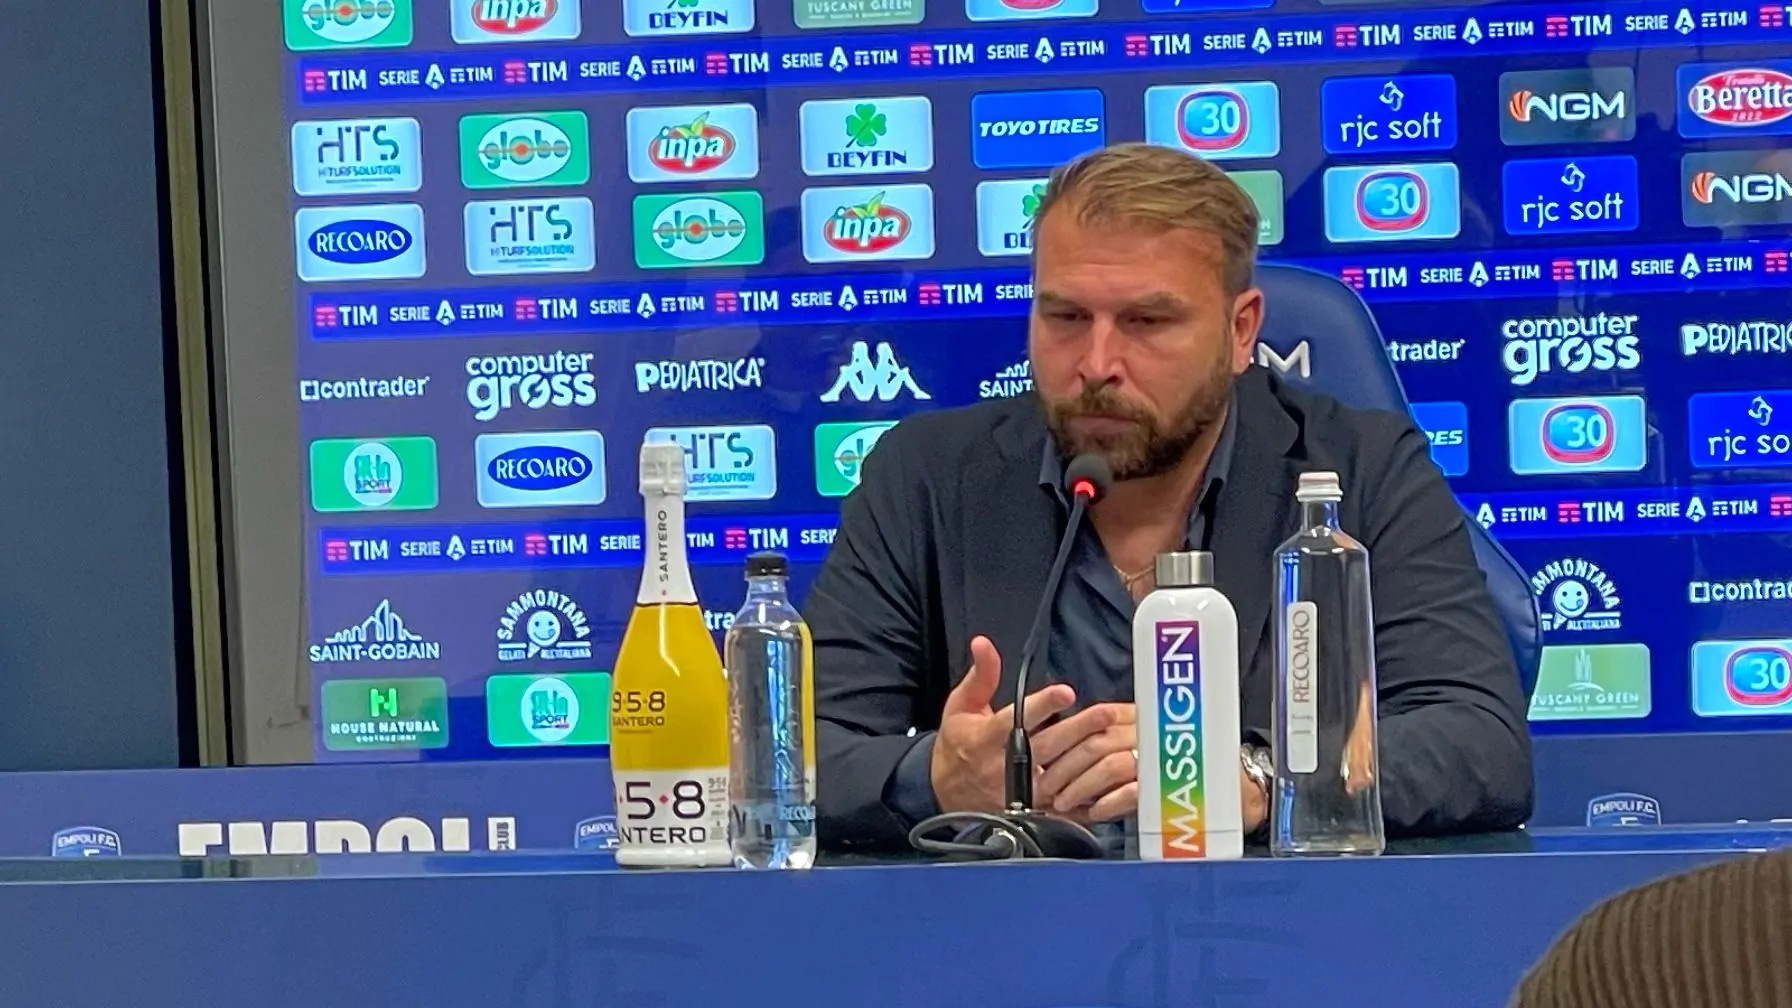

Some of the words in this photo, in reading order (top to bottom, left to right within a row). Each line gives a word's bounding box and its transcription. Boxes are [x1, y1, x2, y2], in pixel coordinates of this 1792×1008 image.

[328, 70, 367, 91] TIM
[379, 71, 420, 86] SERIE
[467, 67, 493, 82] TIM
[528, 62, 568, 83] TIM
[580, 62, 620, 78] SERIE
[669, 59, 695, 74] TIM
[729, 53, 769, 74] TIM
[782, 53, 823, 69] SERIE
[871, 49, 898, 65] TIM
[934, 44, 974, 65] TIM
[987, 45, 1028, 61] SERIE
[1077, 41, 1104, 57] TIM
[1149, 34, 1190, 56] TIM
[1204, 34, 1246, 51] SERIE
[1295, 31, 1323, 47] TIM
[1359, 25, 1400, 46] TIM
[1414, 25, 1456, 41] SERIE
[1506, 21, 1534, 37] TIM
[1571, 15, 1612, 37] TIM
[1625, 15, 1669, 31] SERIE
[1719, 11, 1747, 27] TIM
[1200, 102, 1240, 135] 30
[1525, 91, 1625, 121] NGM
[316, 126, 399, 162] HTS
[1341, 114, 1378, 147] rjc
[1388, 112, 1441, 139] soft
[658, 127, 724, 167] inpa
[827, 150, 907, 168] BEYFIN
[1381, 184, 1420, 216] 30
[1521, 195, 1559, 228] rjc
[1569, 192, 1623, 220] soft
[490, 204, 573, 242] HTS
[834, 206, 901, 247] inpa
[316, 229, 405, 255] RECOARO
[1367, 267, 1408, 288] TIM
[1420, 268, 1462, 284] SERIE
[1513, 264, 1540, 280] TIM
[1577, 258, 1618, 280] TIM
[1631, 259, 1675, 275] SERIE
[1724, 256, 1752, 272] TIM
[339, 305, 378, 327] TIM
[390, 306, 430, 322] SERIE
[477, 304, 503, 319] TIM
[539, 298, 577, 319] TIM
[590, 299, 631, 315] SERIE
[678, 297, 704, 312] TIM
[740, 291, 779, 312] TIM
[791, 291, 833, 308] SERIE
[881, 289, 907, 304] TIM
[942, 283, 982, 304] TIM
[1502, 312, 1640, 343] computer
[466, 349, 595, 377] computer
[1388, 340, 1461, 363] trader
[1503, 336, 1641, 385] gross
[320, 376, 427, 401] contrader
[635, 357, 762, 393] PEDIATRICA
[466, 372, 597, 421] gross
[1565, 415, 1607, 448] 30
[1708, 429, 1746, 461] rjc
[1757, 434, 1792, 456] so
[495, 456, 586, 480] RECOARO
[1518, 506, 1547, 522] TIM
[1583, 501, 1625, 523] TIM
[1637, 502, 1681, 518] SERIE
[1730, 499, 1758, 515] TIM
[350, 539, 389, 561] TIM
[401, 542, 440, 558] SERIE
[487, 538, 513, 554] TIM
[549, 533, 588, 555] TIM
[600, 535, 641, 550] SERIE
[658, 510, 669, 582] SANTERO
[687, 532, 714, 548] TIM
[749, 528, 788, 549] TIM
[1531, 558, 1620, 609] MMONTANA
[496, 588, 591, 641] SAMMONTANA
[310, 642, 440, 662] SAINT-GOBAIN
[1292, 610, 1311, 703] RECOARO
[1750, 657, 1791, 690] 30
[1533, 693, 1590, 706] TUSCANY
[1596, 691, 1640, 704] GREEN
[330, 722, 375, 734] HOUSE
[379, 720, 440, 733] NATURAL
[1162, 627, 1200, 852] MASSIGEN
[1593, 801, 1635, 815] EMPOLI
[58, 833, 97, 848] EMPOLI
[580, 822, 617, 836] EMPOL
[621, 826, 706, 845] NTERO
